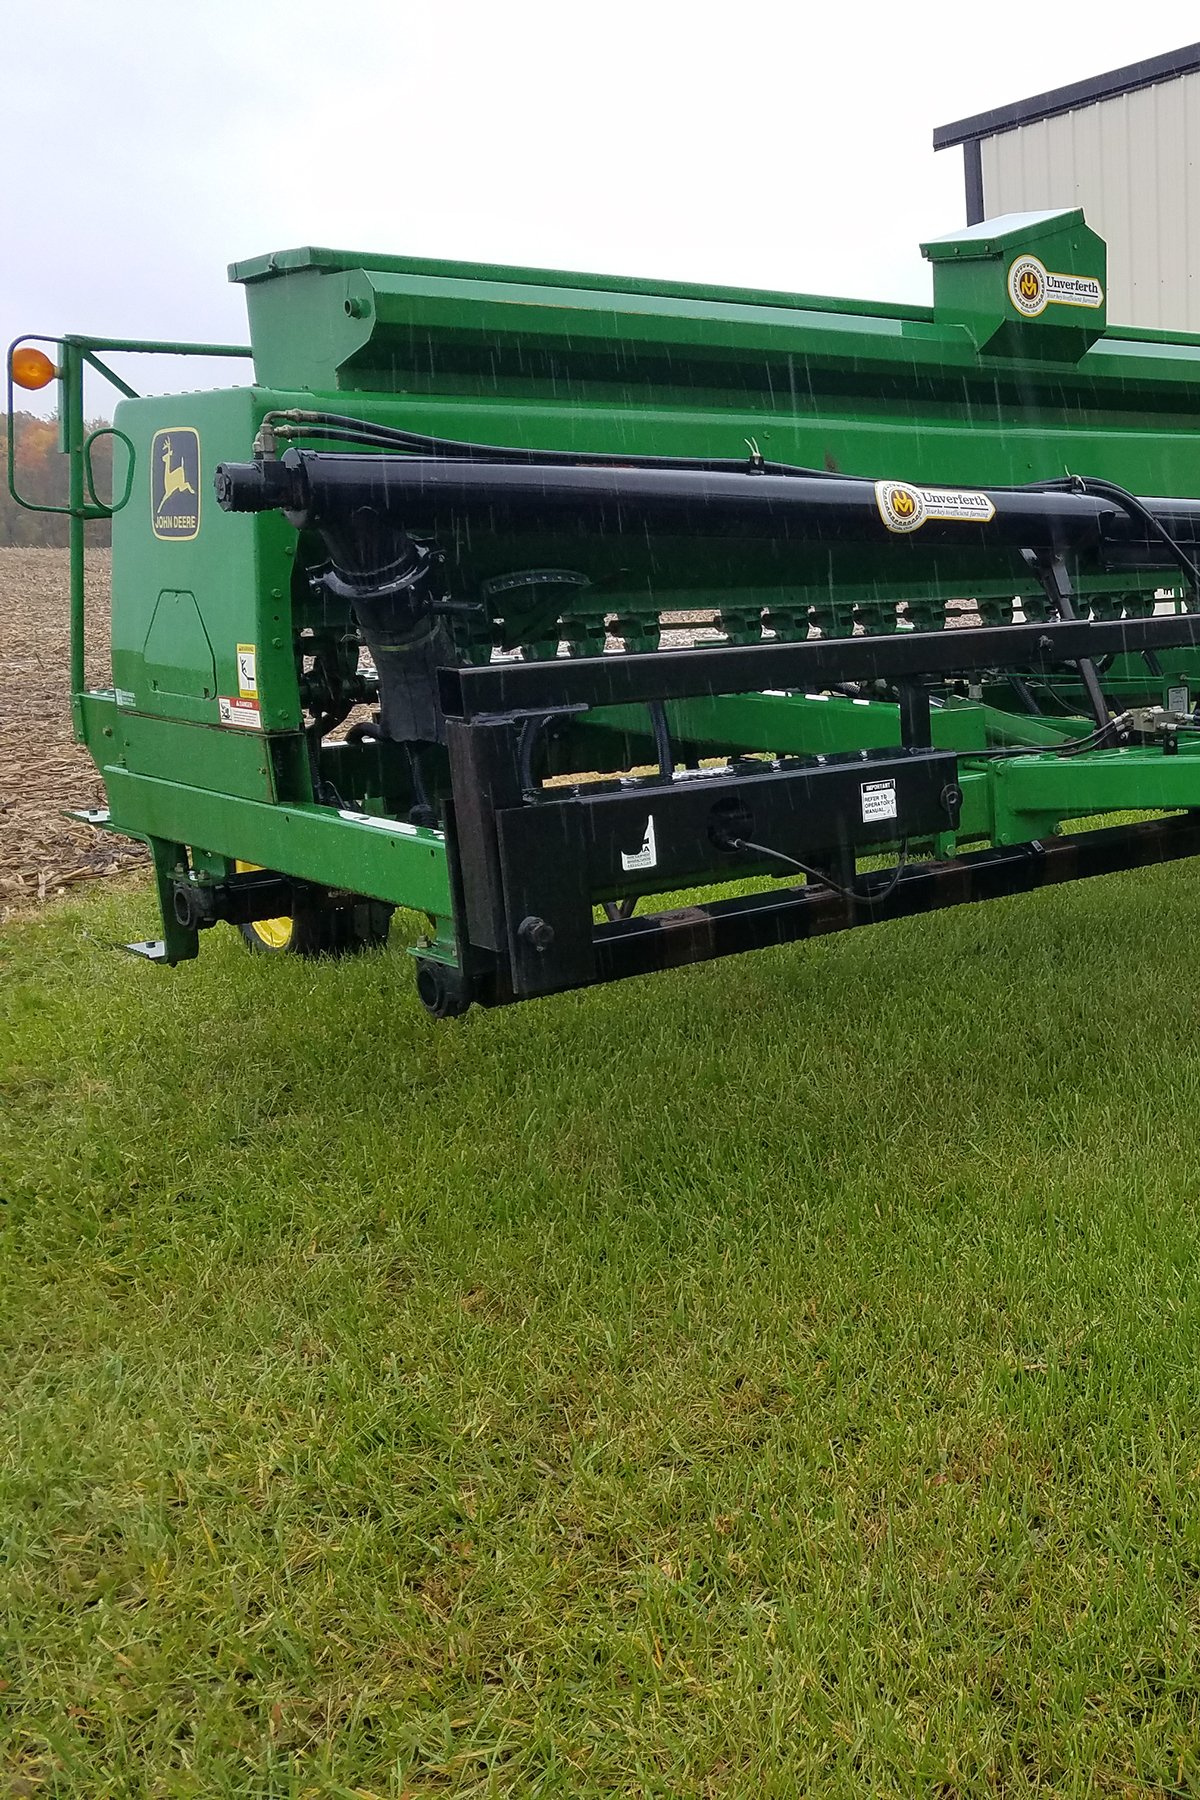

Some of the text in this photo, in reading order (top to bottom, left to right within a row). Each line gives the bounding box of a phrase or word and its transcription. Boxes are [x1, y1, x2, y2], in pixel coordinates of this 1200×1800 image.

[1046, 276, 1099, 293] Unverferth
[921, 492, 988, 506] Unverferth
[155, 515, 196, 529] JOHN DEERE
